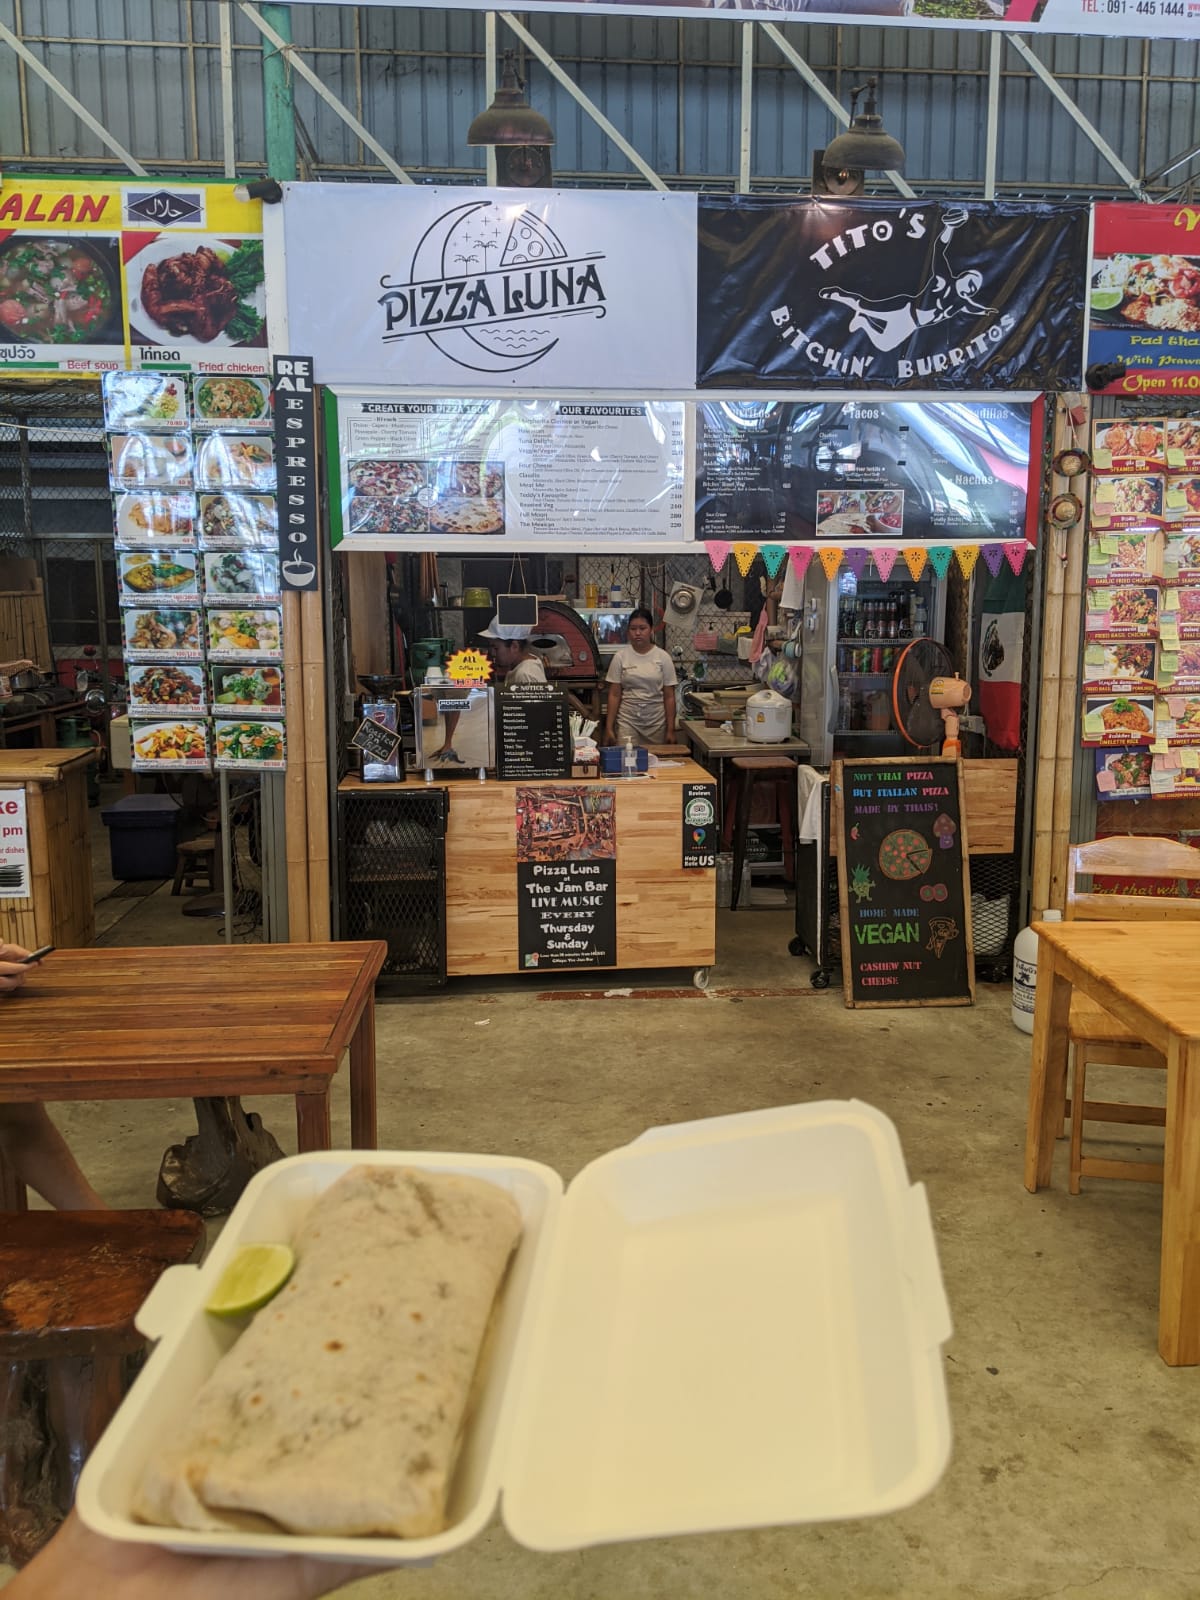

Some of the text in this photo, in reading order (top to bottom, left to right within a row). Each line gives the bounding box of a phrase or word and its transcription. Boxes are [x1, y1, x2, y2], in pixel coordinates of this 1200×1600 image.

[1082, 0, 1098, 12] TEL
[1107, 0, 1126, 13] 091
[1136, 1, 1156, 15] 445
[1160, 3, 1184, 16] 1444
[0, 193, 109, 223] ALAN
[809, 207, 927, 272] TITO'S
[378, 264, 607, 331] PIZZA LUNA
[896, 313, 1016, 379] BURRITOS
[1130, 335, 1200, 347] Pad tha
[139, 346, 181, 361] ไก่ทอด
[67, 360, 119, 372] Beef soup
[199, 361, 266, 373] Fried chicken
[1122, 375, 1200, 393] Open 11.0
[368, 404, 405, 413] CREATE
[407, 405, 434, 413] YOUR
[561, 407, 642, 417] OUR FAVOURITES
[285, 398, 308, 543] ESPRESSO
[955, 474, 994, 486] Nachos
[362, 720, 396, 747] Roasted
[876, 771, 903, 781] THAI
[906, 771, 934, 780] PIZZA
[922, 786, 950, 796] PIZZA
[854, 804, 881, 814] MADE
[3, 827, 23, 838] pm
[698, 855, 714, 867] US
[533, 863, 601, 876] Pizza Luna
[526, 880, 608, 894] The Jam Bar
[531, 896, 604, 908] LIVE MUSIC
[541, 911, 596, 920] EVERY
[540, 923, 595, 935] Thursday
[854, 921, 920, 945] VEGAN
[546, 939, 589, 951] Sunday
